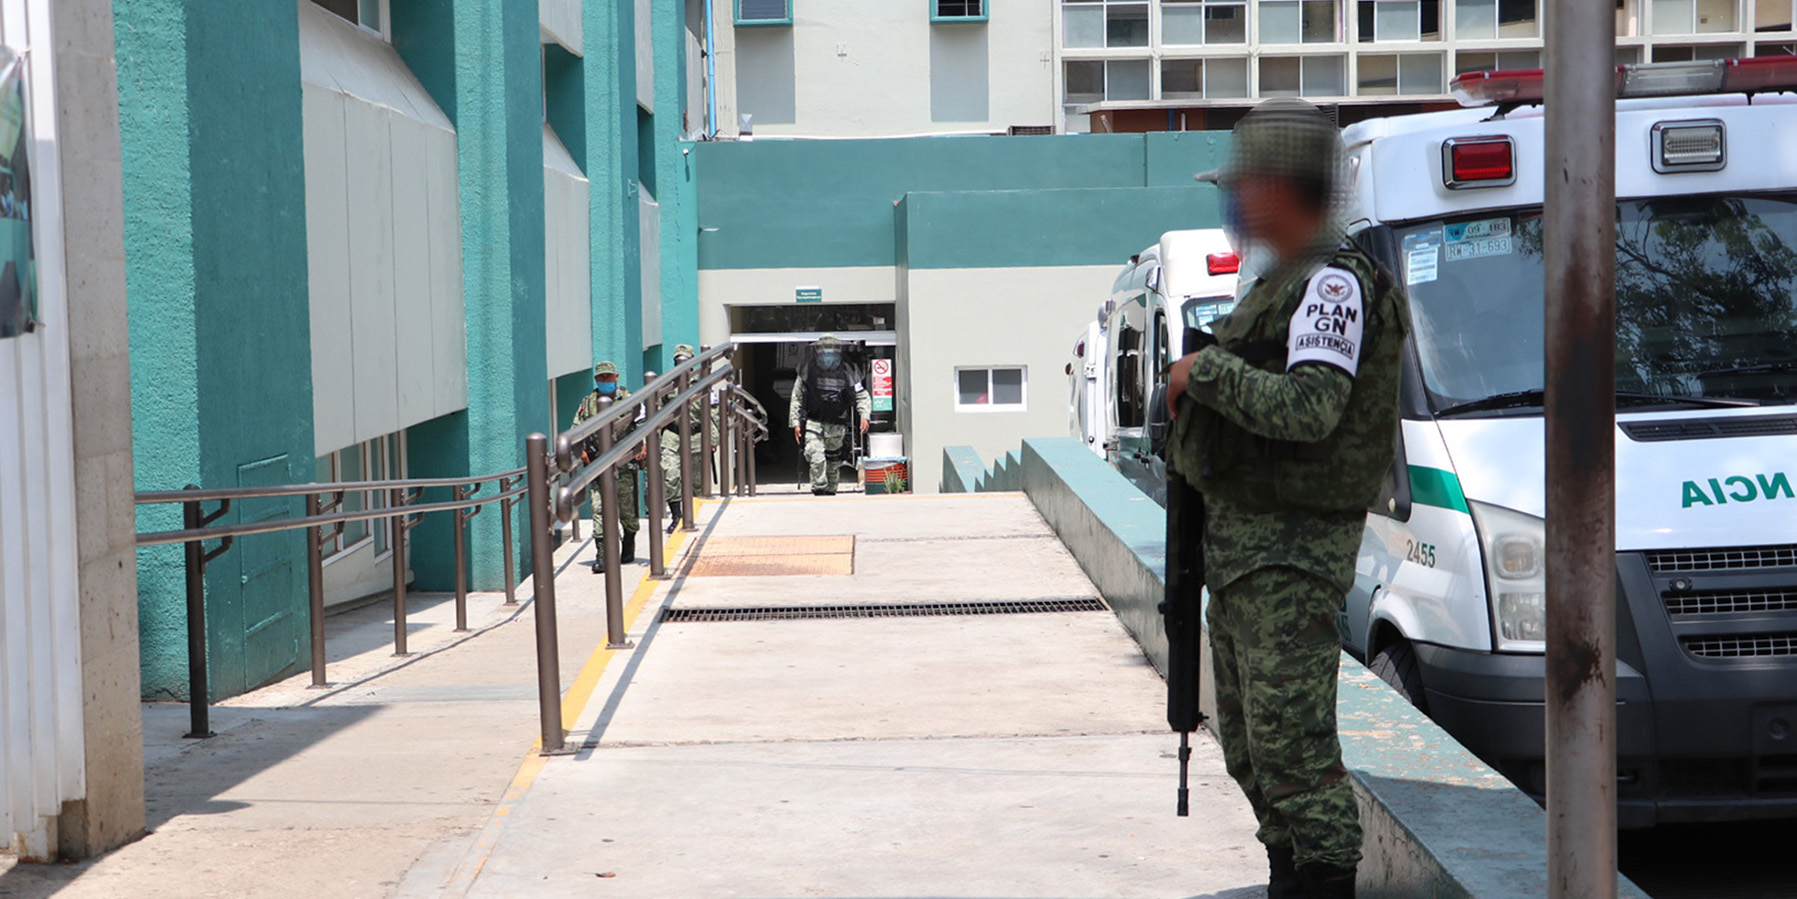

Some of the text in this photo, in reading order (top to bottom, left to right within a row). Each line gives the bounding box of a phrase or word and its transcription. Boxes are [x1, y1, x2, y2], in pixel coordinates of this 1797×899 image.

[1306, 303, 1357, 323] PLAN
[1314, 316, 1346, 336] GN
[1299, 335, 1352, 354] ASISTENCIA
[1406, 539, 1436, 568] 2455
